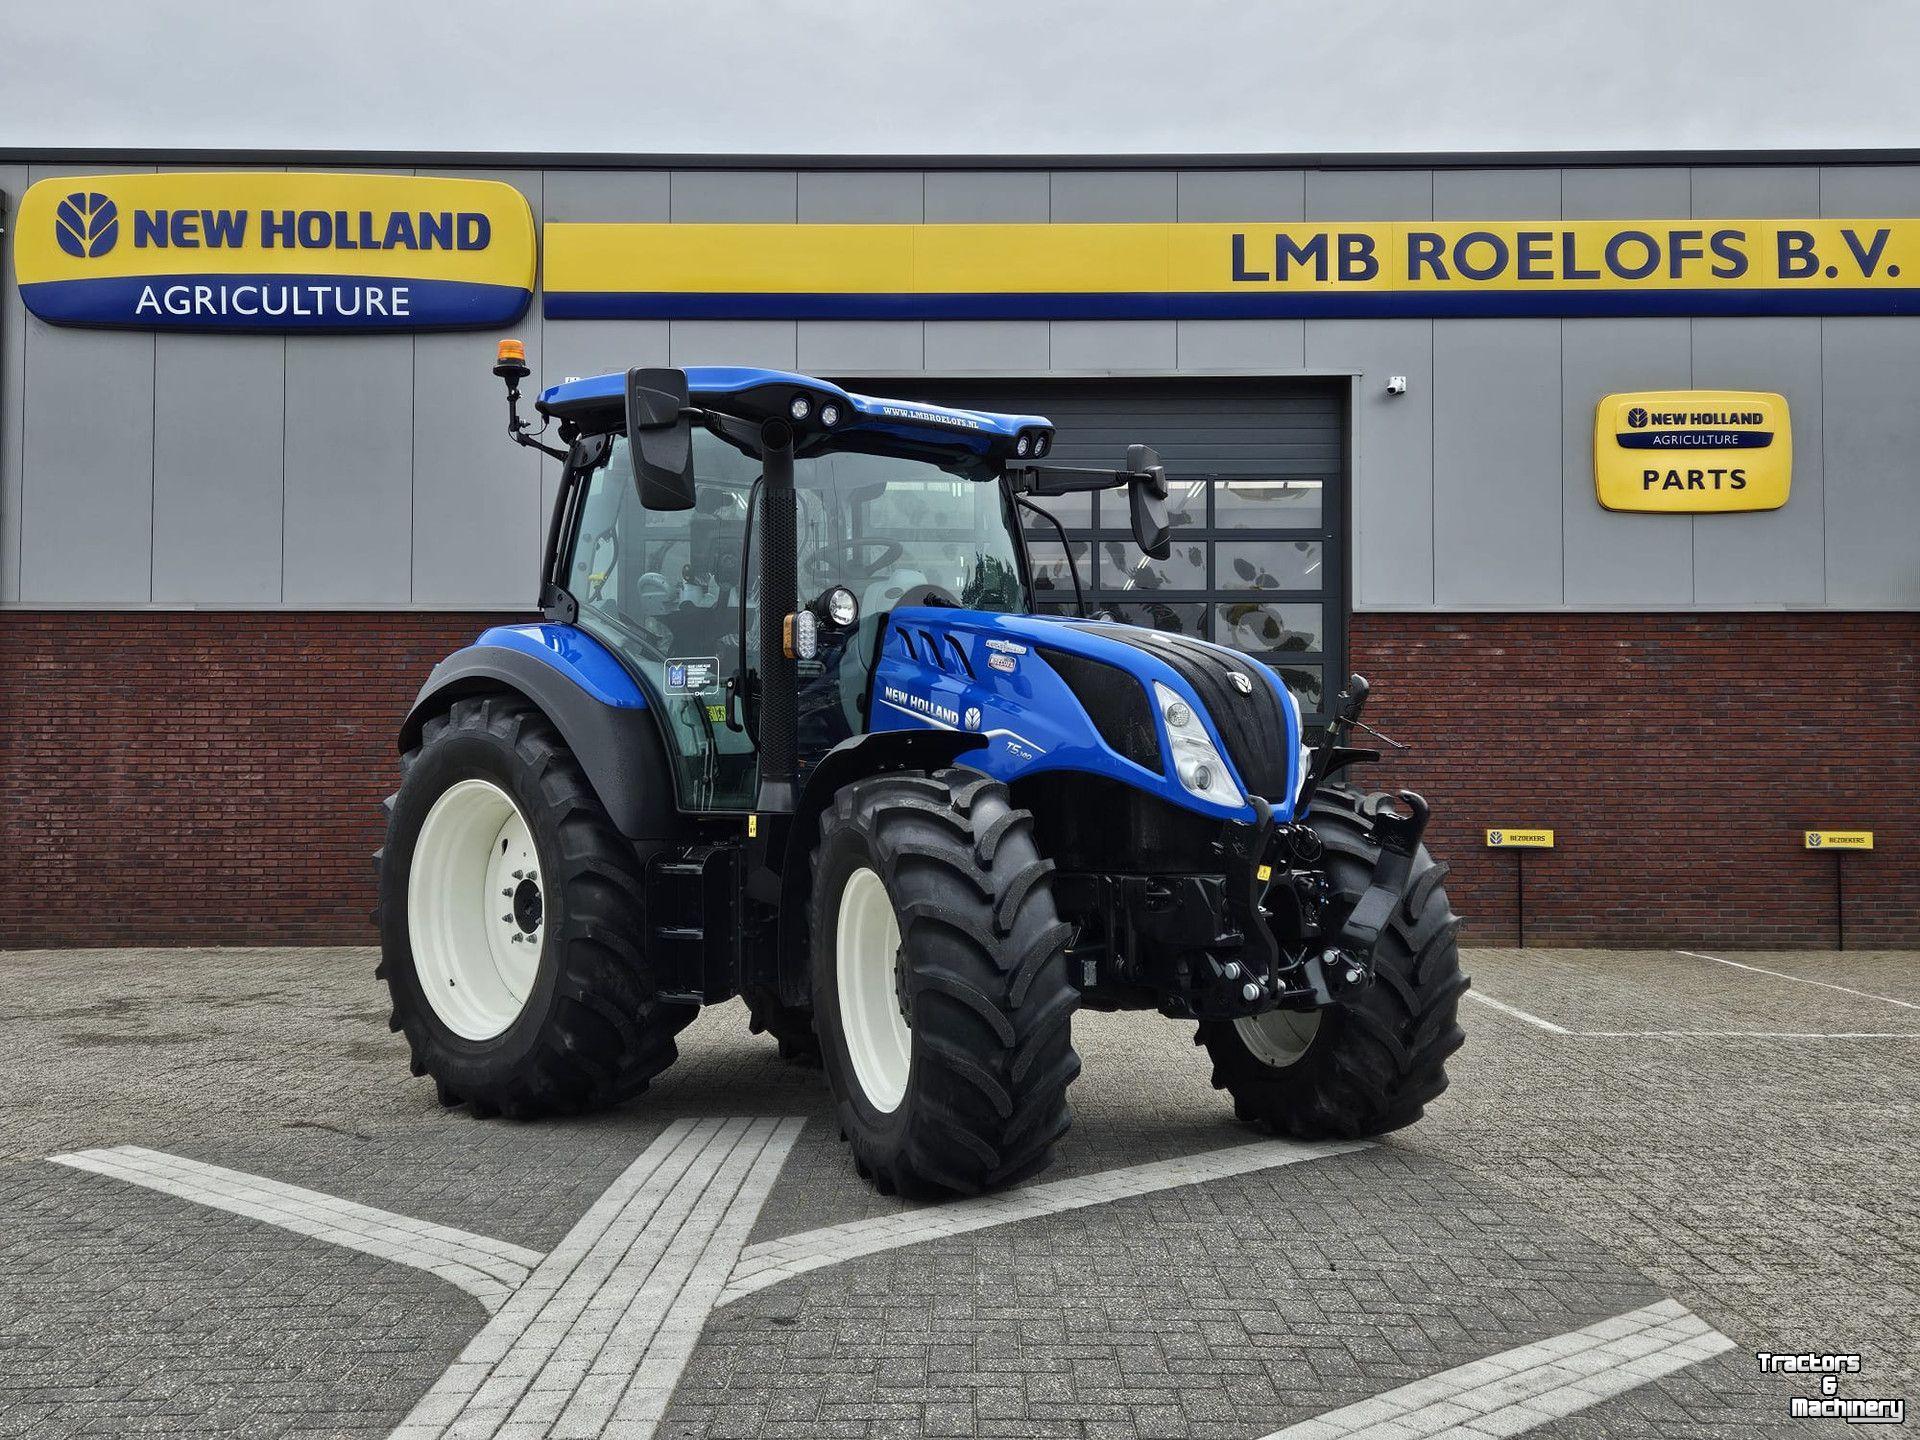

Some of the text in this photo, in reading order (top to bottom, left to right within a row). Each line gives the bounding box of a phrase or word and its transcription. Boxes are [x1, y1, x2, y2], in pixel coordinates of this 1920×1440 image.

[134, 209, 492, 252] NEW HOLLAND
[1231, 228, 1902, 282] LMB ROELOFS B.V.
[135, 285, 411, 317] AGRICULTURE
[1651, 412, 1764, 426] NEW HOLLAND
[1652, 434, 1739, 446] AGRICULTURE
[1643, 468, 1748, 491] PARTS
[884, 686, 960, 726] NEW HOLLAND
